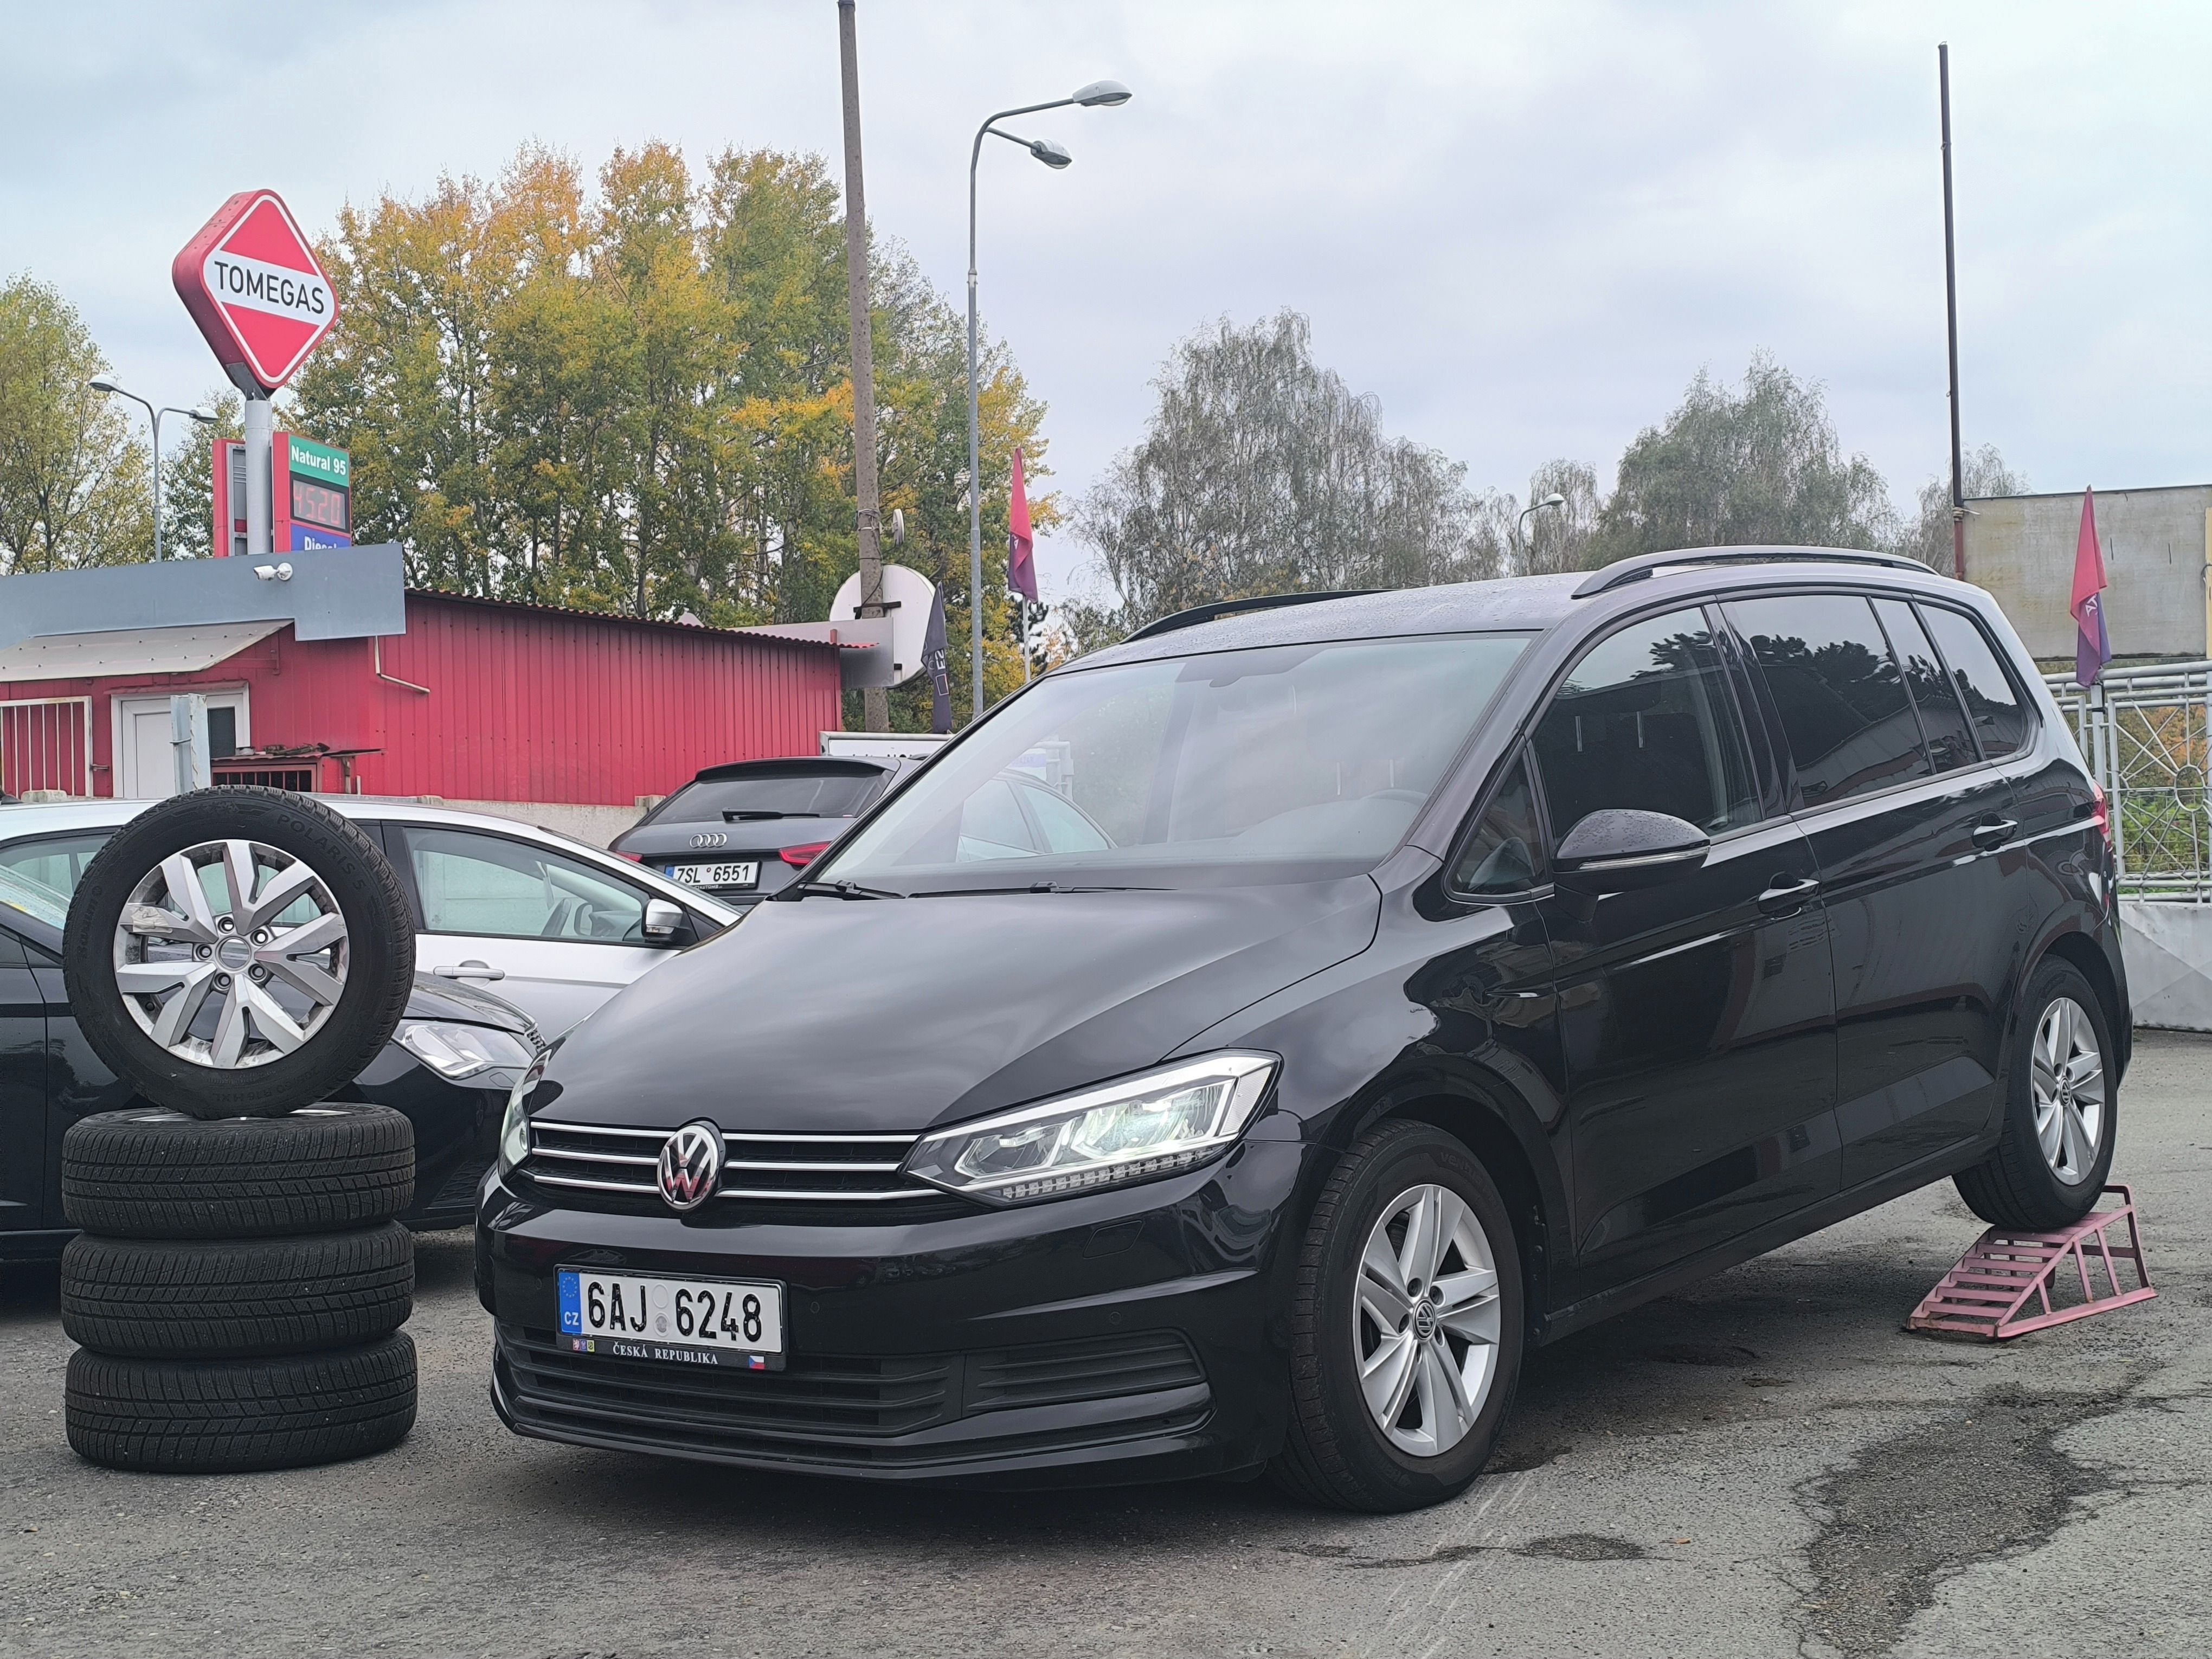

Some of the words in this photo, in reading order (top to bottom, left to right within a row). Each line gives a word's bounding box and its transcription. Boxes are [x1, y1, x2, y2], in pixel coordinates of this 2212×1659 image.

[214, 260, 324, 314] TOMEGAS
[291, 445, 330, 471] Natural
[333, 458, 346, 475] 95
[277, 814, 356, 874] POLARIS
[352, 879, 366, 890] 5
[678, 867, 700, 883] 7SL
[713, 864, 749, 882] 6551
[564, 1311, 579, 1326] CZ
[588, 1281, 647, 1332] 6AJ
[676, 1288, 762, 1342] 6248
[613, 1341, 648, 1358] ČESKÁ
[654, 1348, 718, 1365] REPUBLIKA
